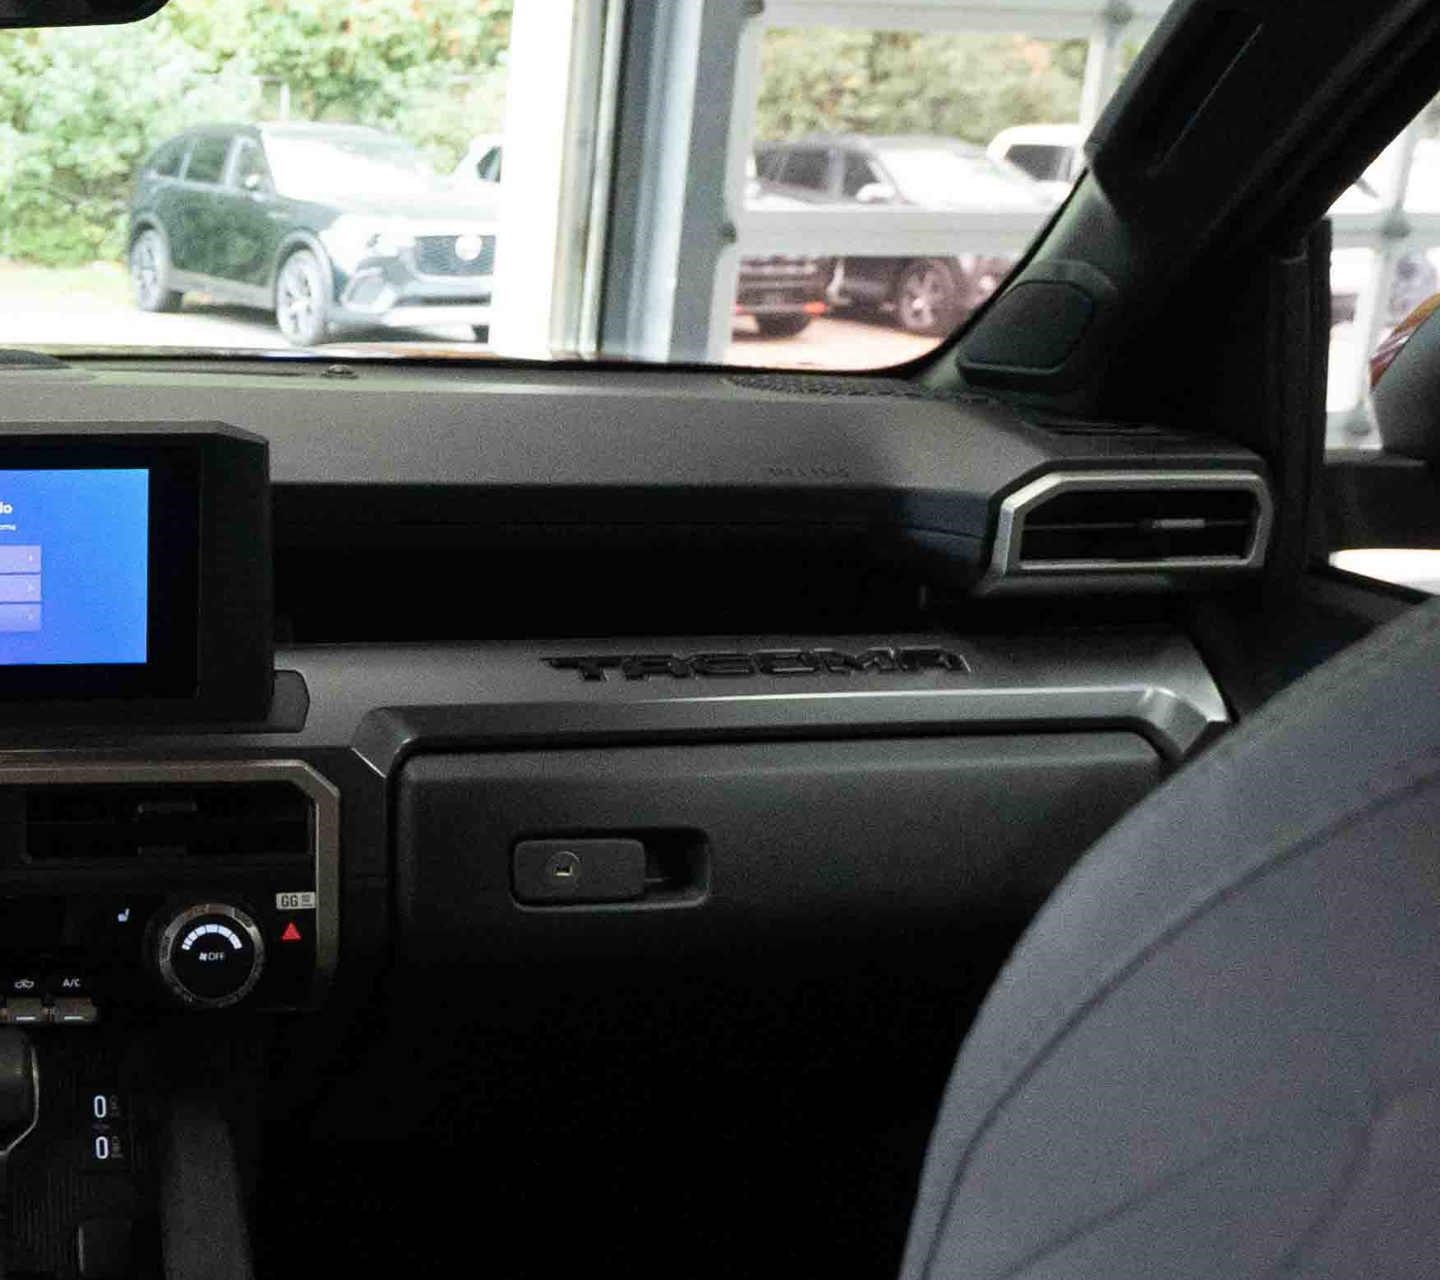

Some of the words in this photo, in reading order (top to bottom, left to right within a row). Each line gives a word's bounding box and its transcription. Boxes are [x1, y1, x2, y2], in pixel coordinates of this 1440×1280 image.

[540, 647, 971, 681] TACOMA
[208, 951, 224, 961] OFF
[62, 977, 81, 988] A/C
